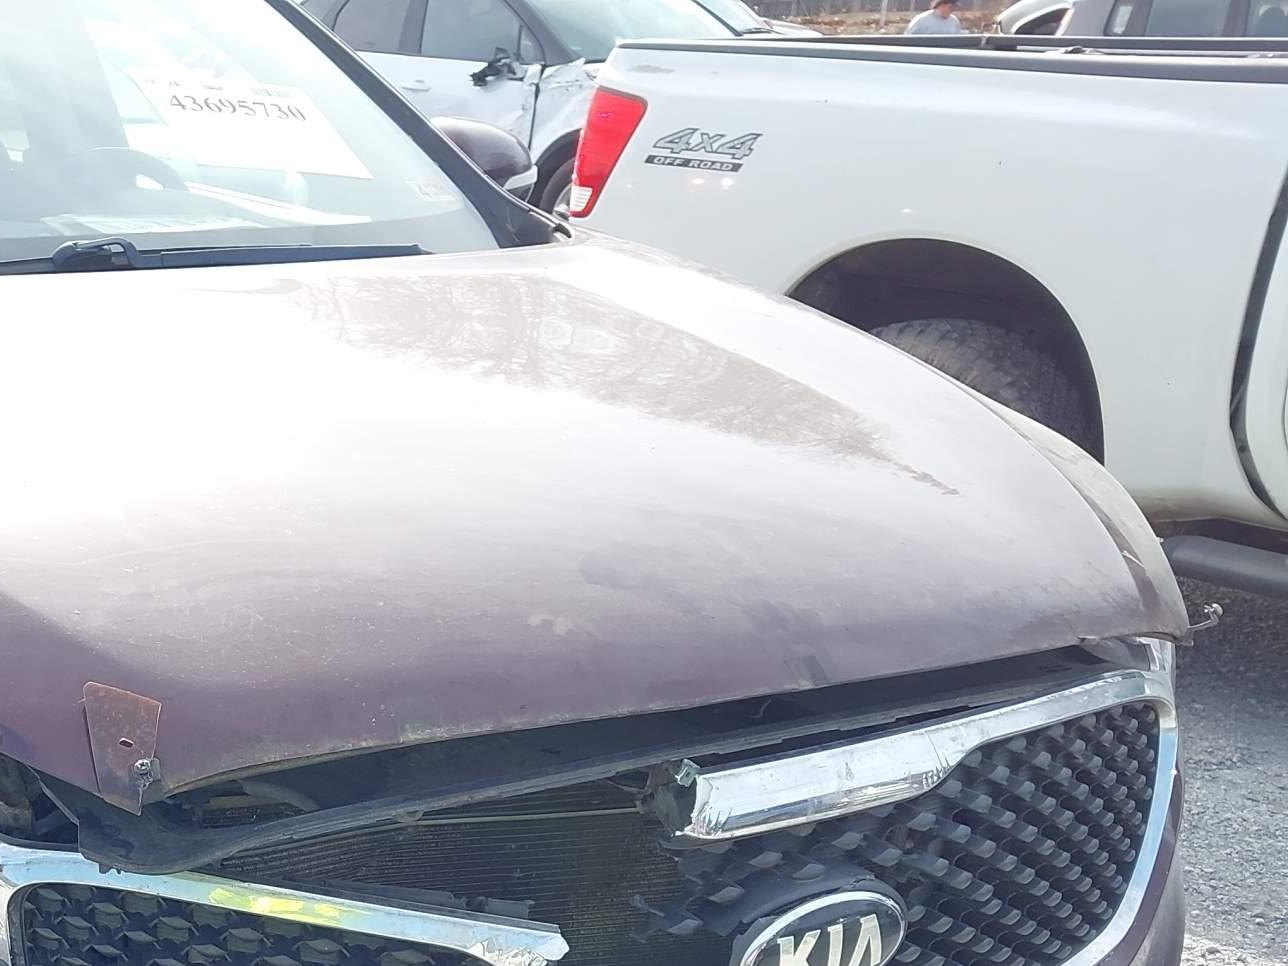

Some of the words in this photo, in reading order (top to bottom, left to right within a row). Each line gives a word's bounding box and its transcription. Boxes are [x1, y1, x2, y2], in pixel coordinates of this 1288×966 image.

[170, 94, 307, 121] 43695730
[654, 156, 684, 166] OFF
[690, 160, 734, 172] ROAD
